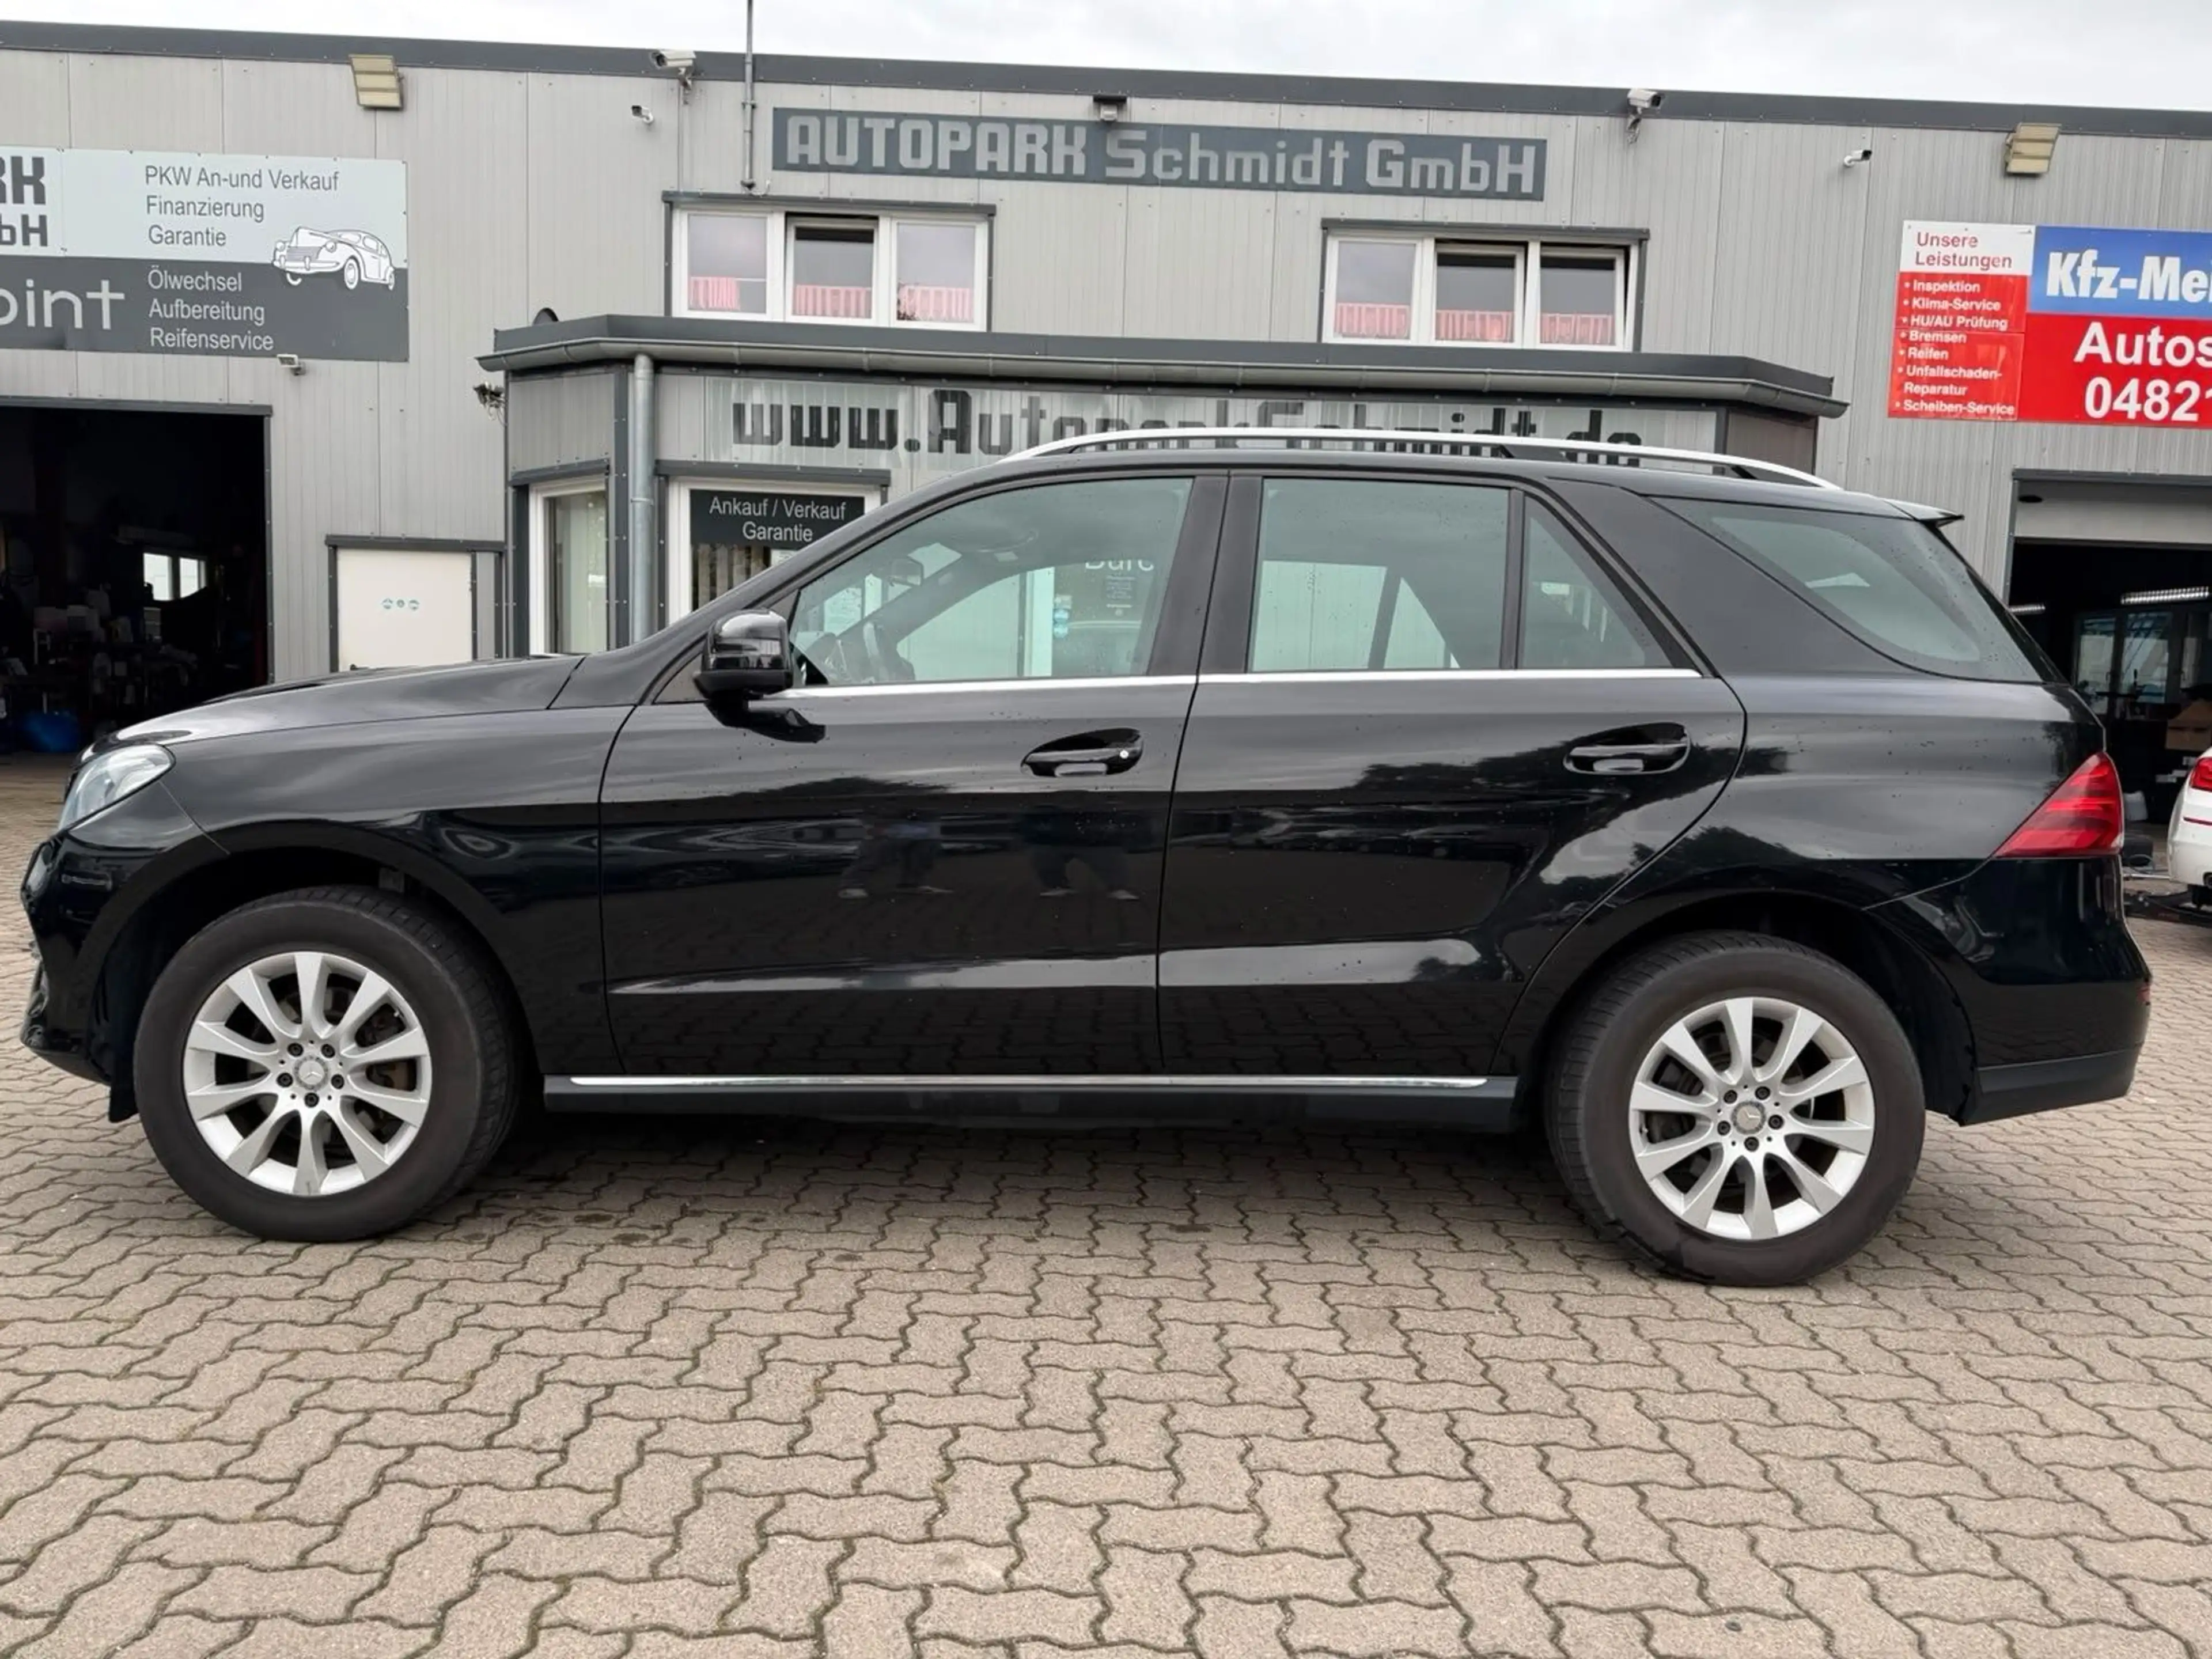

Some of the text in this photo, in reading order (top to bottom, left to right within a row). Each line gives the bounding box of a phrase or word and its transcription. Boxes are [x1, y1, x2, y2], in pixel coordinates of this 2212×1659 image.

[786, 116, 1536, 194] AUTOPARK Schmidt GmbH
[145, 165, 340, 191] PKW An-und Verkauf
[146, 195, 264, 223] Finanzierung
[149, 224, 227, 247] Garantie
[1917, 232, 1978, 247] Unsere
[1914, 251, 2013, 271] Leistungen
[147, 264, 243, 291] Ölwechsel
[2046, 249, 2212, 302] Kfz-Me
[1913, 279, 1980, 294] Inspektion
[148, 298, 266, 326] Aufbereitung
[1912, 297, 2002, 311] Klima-Service
[1911, 315, 2009, 331] HU/AU Prüfung
[150, 327, 274, 351] Reifenservice
[1909, 330, 1967, 343] Bremsen
[1908, 347, 1949, 360] Reifen
[1906, 365, 2002, 379] Unfallschaden-
[1904, 381, 1968, 396] Reparatur
[1903, 400, 2015, 415] Scheiben-Service
[2085, 376, 2212, 422] 0482
[709, 496, 769, 517] Ankauf
[782, 499, 846, 521] Verkauf
[743, 521, 813, 541] Garantie
